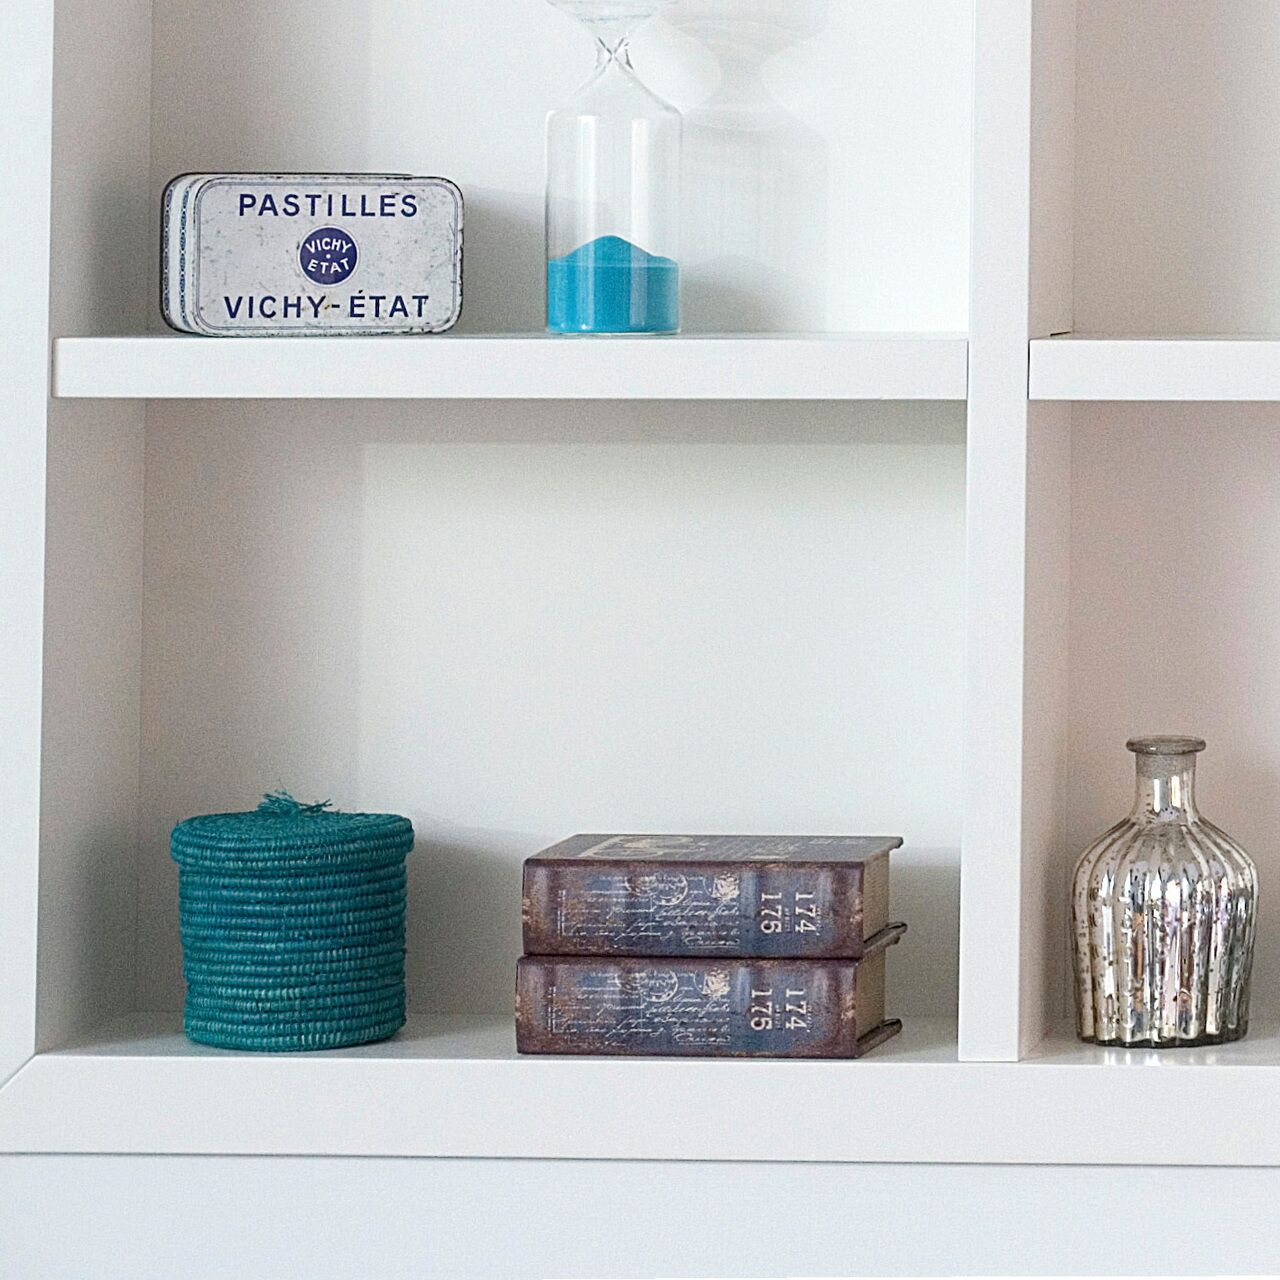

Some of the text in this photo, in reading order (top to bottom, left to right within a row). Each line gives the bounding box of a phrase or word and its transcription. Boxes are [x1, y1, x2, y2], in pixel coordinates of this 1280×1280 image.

[239, 193, 417, 217] PASTILLES
[305, 238, 351, 254] VICHY
[307, 258, 351, 274] ETAT
[224, 289, 429, 319] VICHY-ÉTAT
[761, 891, 783, 934] 175
[794, 892, 816, 934] 174
[750, 988, 773, 1031] 175
[785, 988, 807, 1030] 174
